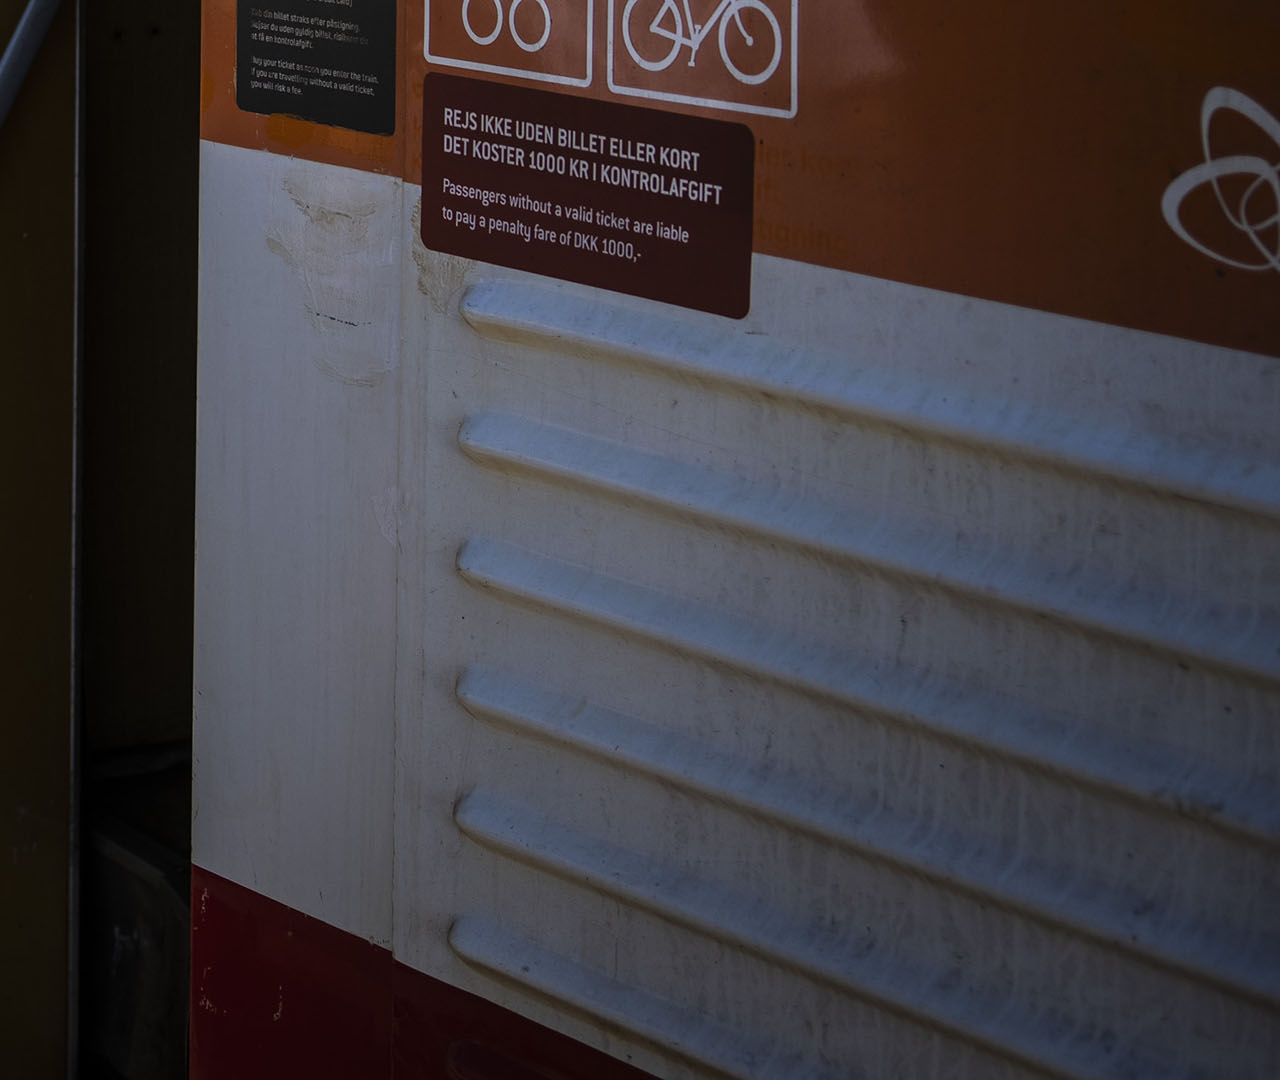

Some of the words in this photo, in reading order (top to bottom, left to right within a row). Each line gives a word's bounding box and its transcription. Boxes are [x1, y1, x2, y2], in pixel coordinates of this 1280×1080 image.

[273, 11, 290, 21] billet
[279, 23, 295, 33] uden
[266, 34, 274, 42] en
[320, 67, 332, 76] you
[350, 71, 361, 81] the
[250, 80, 262, 89] you
[338, 83, 354, 93] valid
[444, 107, 478, 131] REJS
[480, 113, 513, 137] IKKE
[515, 120, 554, 145] UDEN
[557, 127, 607, 155] BILLET
[609, 137, 656, 164] ELLER
[659, 146, 700, 172] KORT
[443, 134, 470, 156] DET
[472, 139, 525, 168] KOSTER
[528, 150, 566, 175] 1000
[569, 158, 590, 180] KR
[592, 162, 597, 181] I
[600, 163, 723, 206] KONTROLAFGIFT
[443, 177, 507, 207] Passengers
[509, 192, 552, 215] without
[555, 204, 562, 217] a
[564, 206, 593, 224] valid
[596, 210, 630, 231] ticket
[633, 220, 654, 236] are
[656, 221, 689, 243] liable
[441, 205, 453, 221] to
[455, 210, 476, 231] pay
[479, 215, 486, 228] a
[488, 217, 532, 243] penalty
[533, 223, 557, 243] fare
[559, 230, 572, 246] of
[574, 231, 599, 253] DKK
[601, 238, 642, 263] 1000,-
